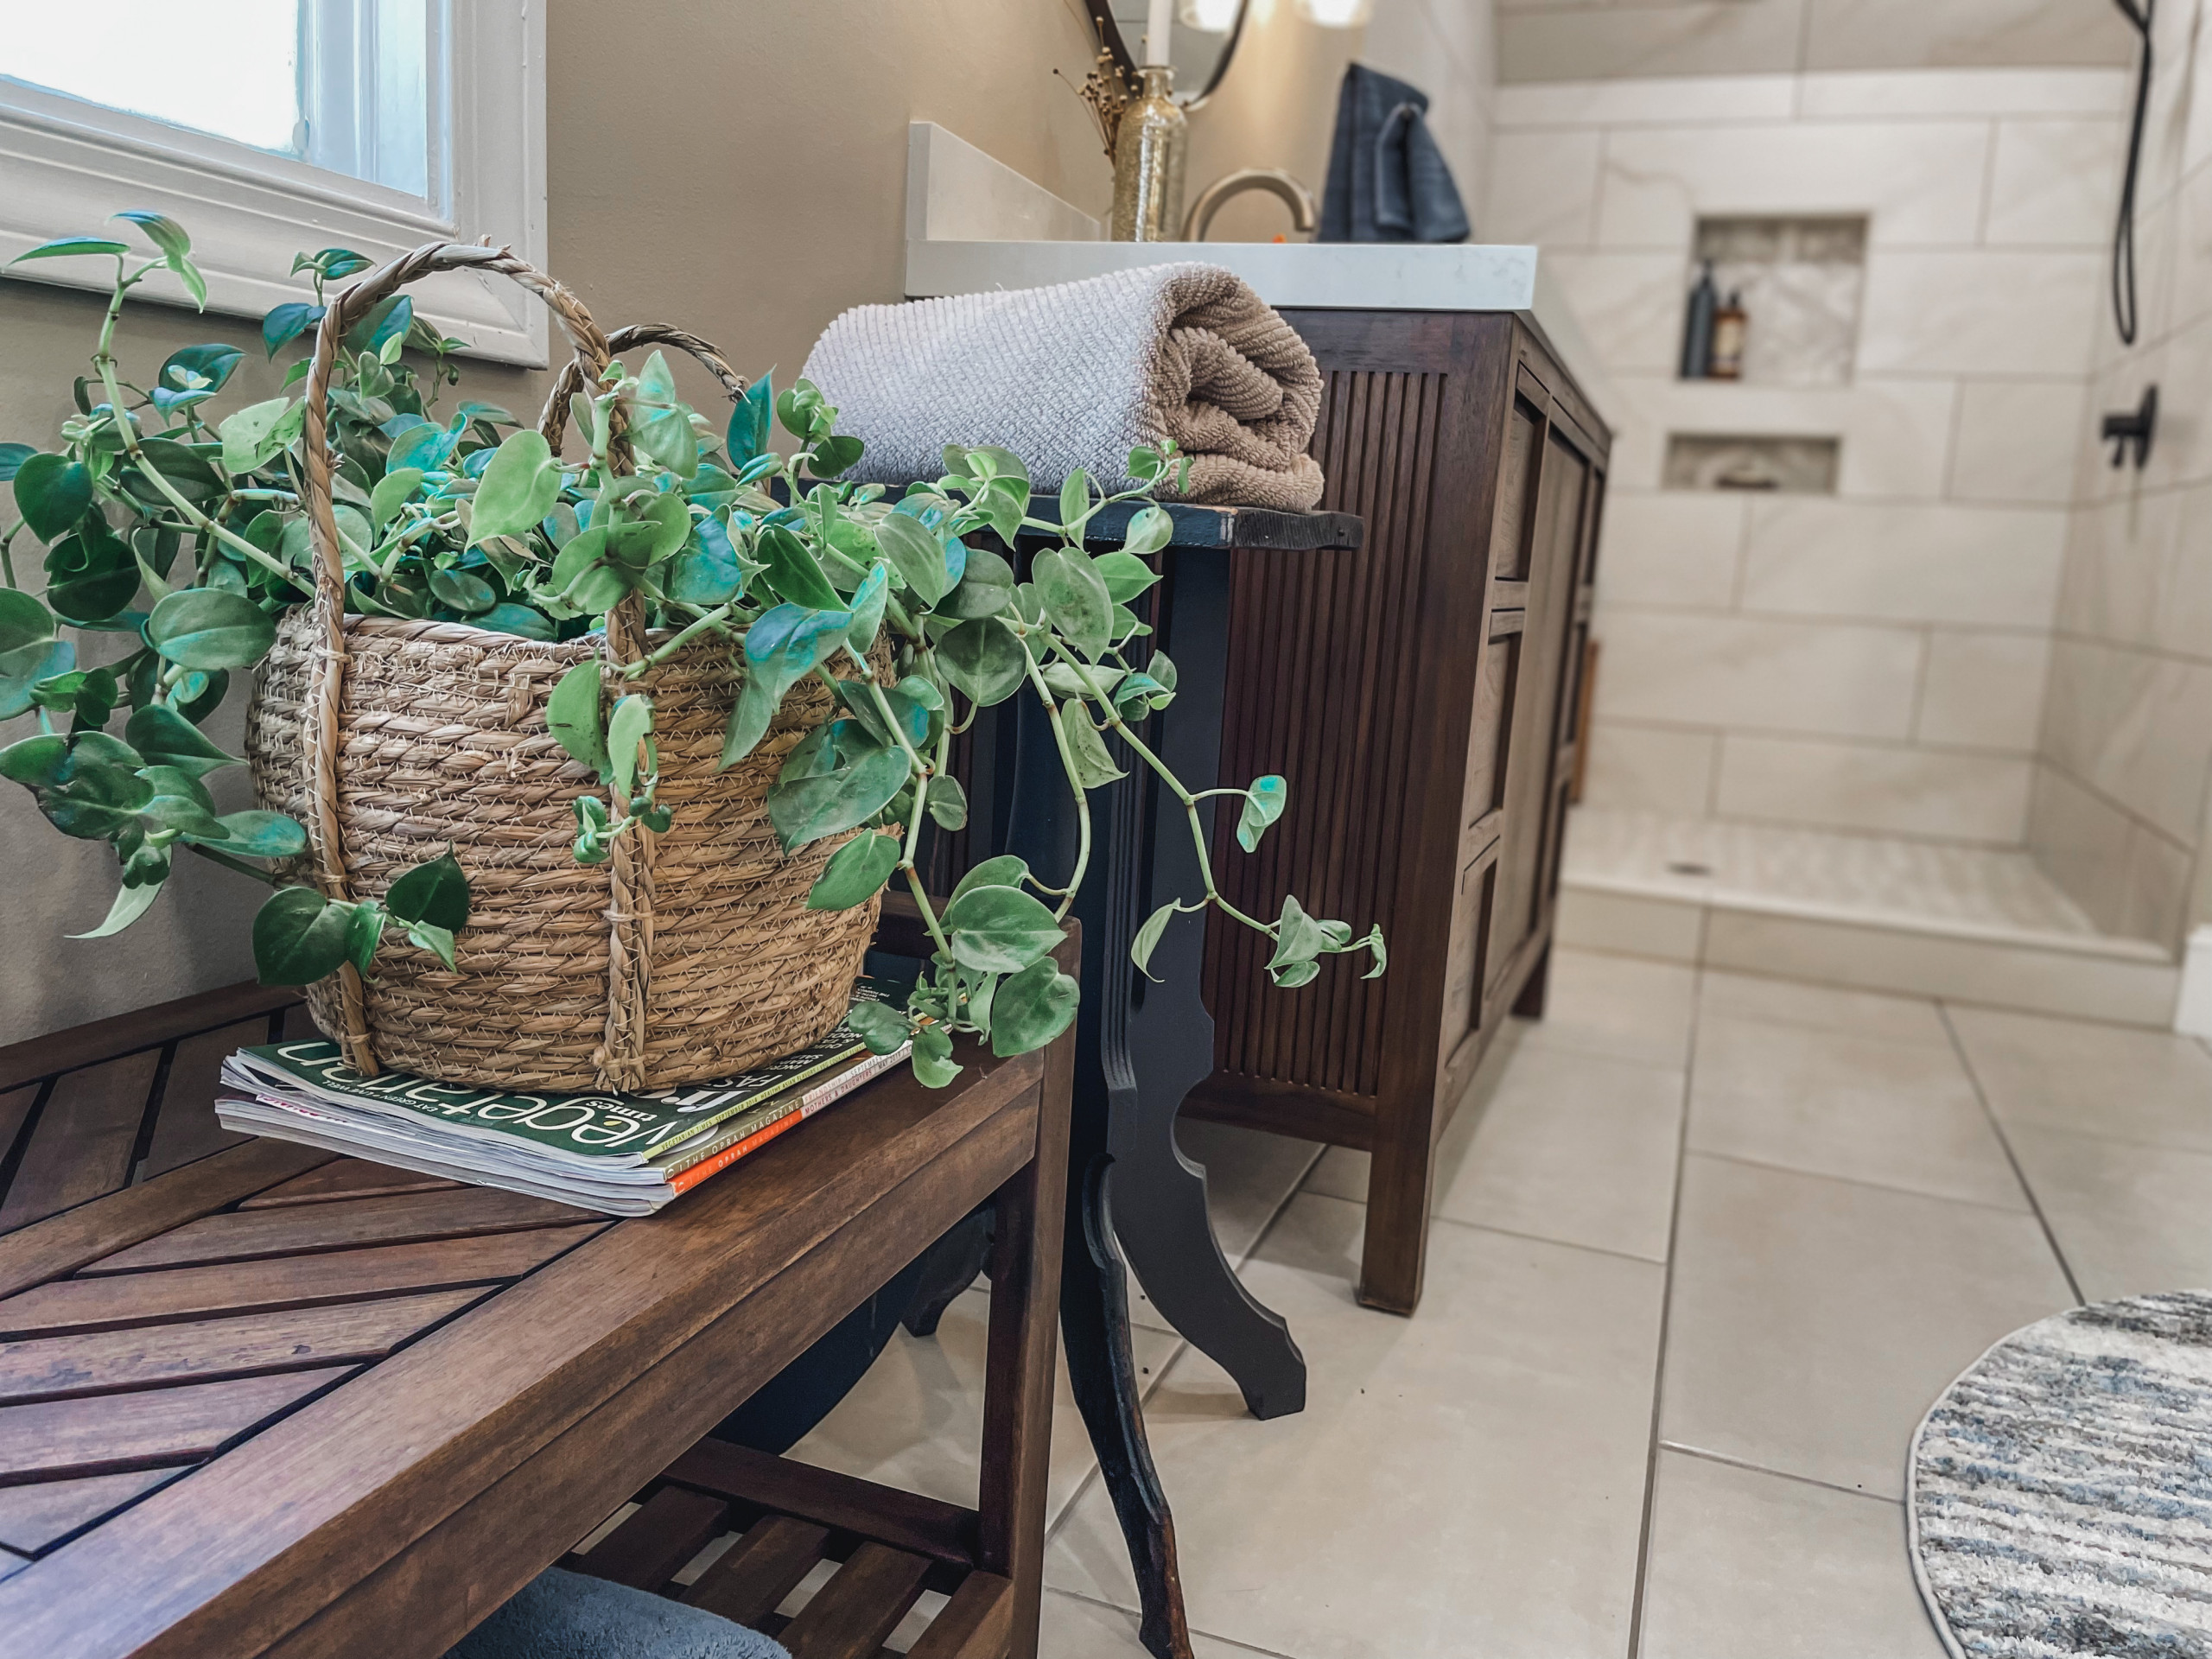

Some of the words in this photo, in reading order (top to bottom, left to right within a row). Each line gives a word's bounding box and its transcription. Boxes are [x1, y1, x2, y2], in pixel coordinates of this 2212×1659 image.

[702, 1074, 783, 1090] FAS
[805, 1095, 832, 1116] MOTHERS
[841, 1070, 872, 1093] DAUGHTERS
[878, 1061, 888, 1071] MAY
[805, 1078, 842, 1103] FRIENDSHIP
[380, 1095, 417, 1108] GREEN
[414, 1103, 438, 1112] EAT
[586, 1100, 657, 1122] times
[661, 1129, 694, 1151] VEGETARIAN
[696, 1121, 713, 1132] TIMES
[715, 1105, 745, 1122] SEPTEMBER
[782, 1078, 796, 1089] ASIAN
[685, 1152, 705, 1168] THE
[711, 1131, 746, 1154] OPRAH
[750, 1100, 800, 1133] MAGAZINE
[718, 1146, 748, 1166] OPRAH
[752, 1117, 794, 1146] MAGAZINE
